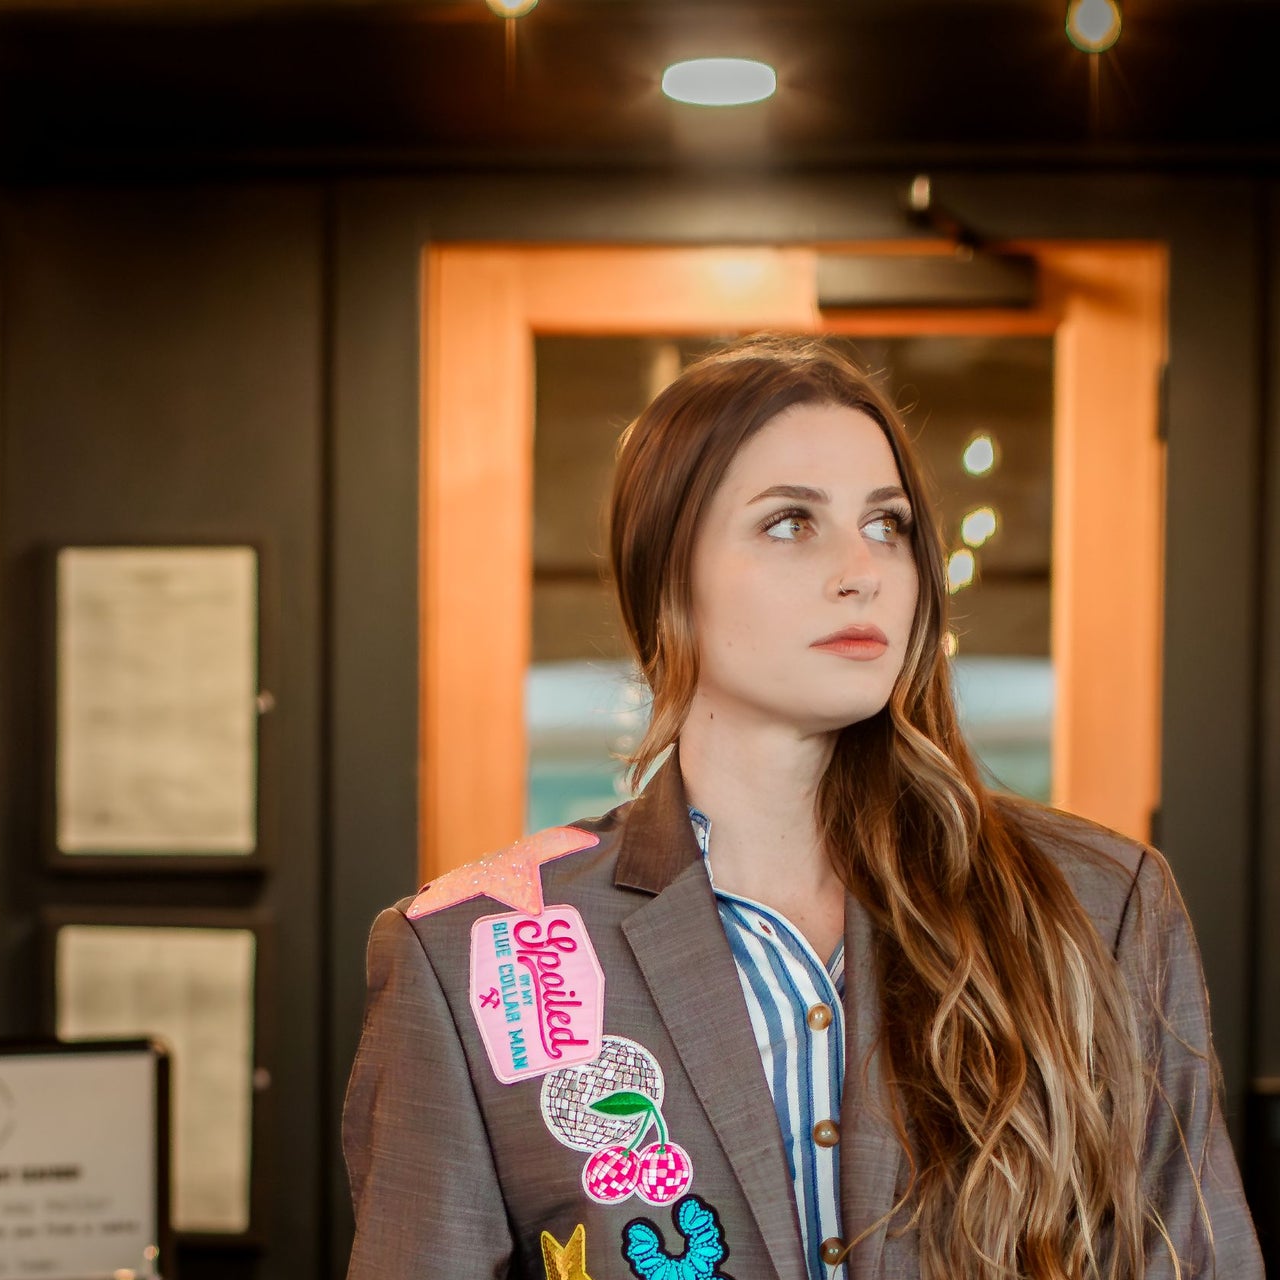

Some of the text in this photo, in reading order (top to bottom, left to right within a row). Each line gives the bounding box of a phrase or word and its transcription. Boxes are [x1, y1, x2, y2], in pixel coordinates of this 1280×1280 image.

[492, 921, 529, 1070] BLUE COLLAR MAN
[513, 919, 589, 1060] Spoiled
[518, 973, 533, 1006] BY MY
